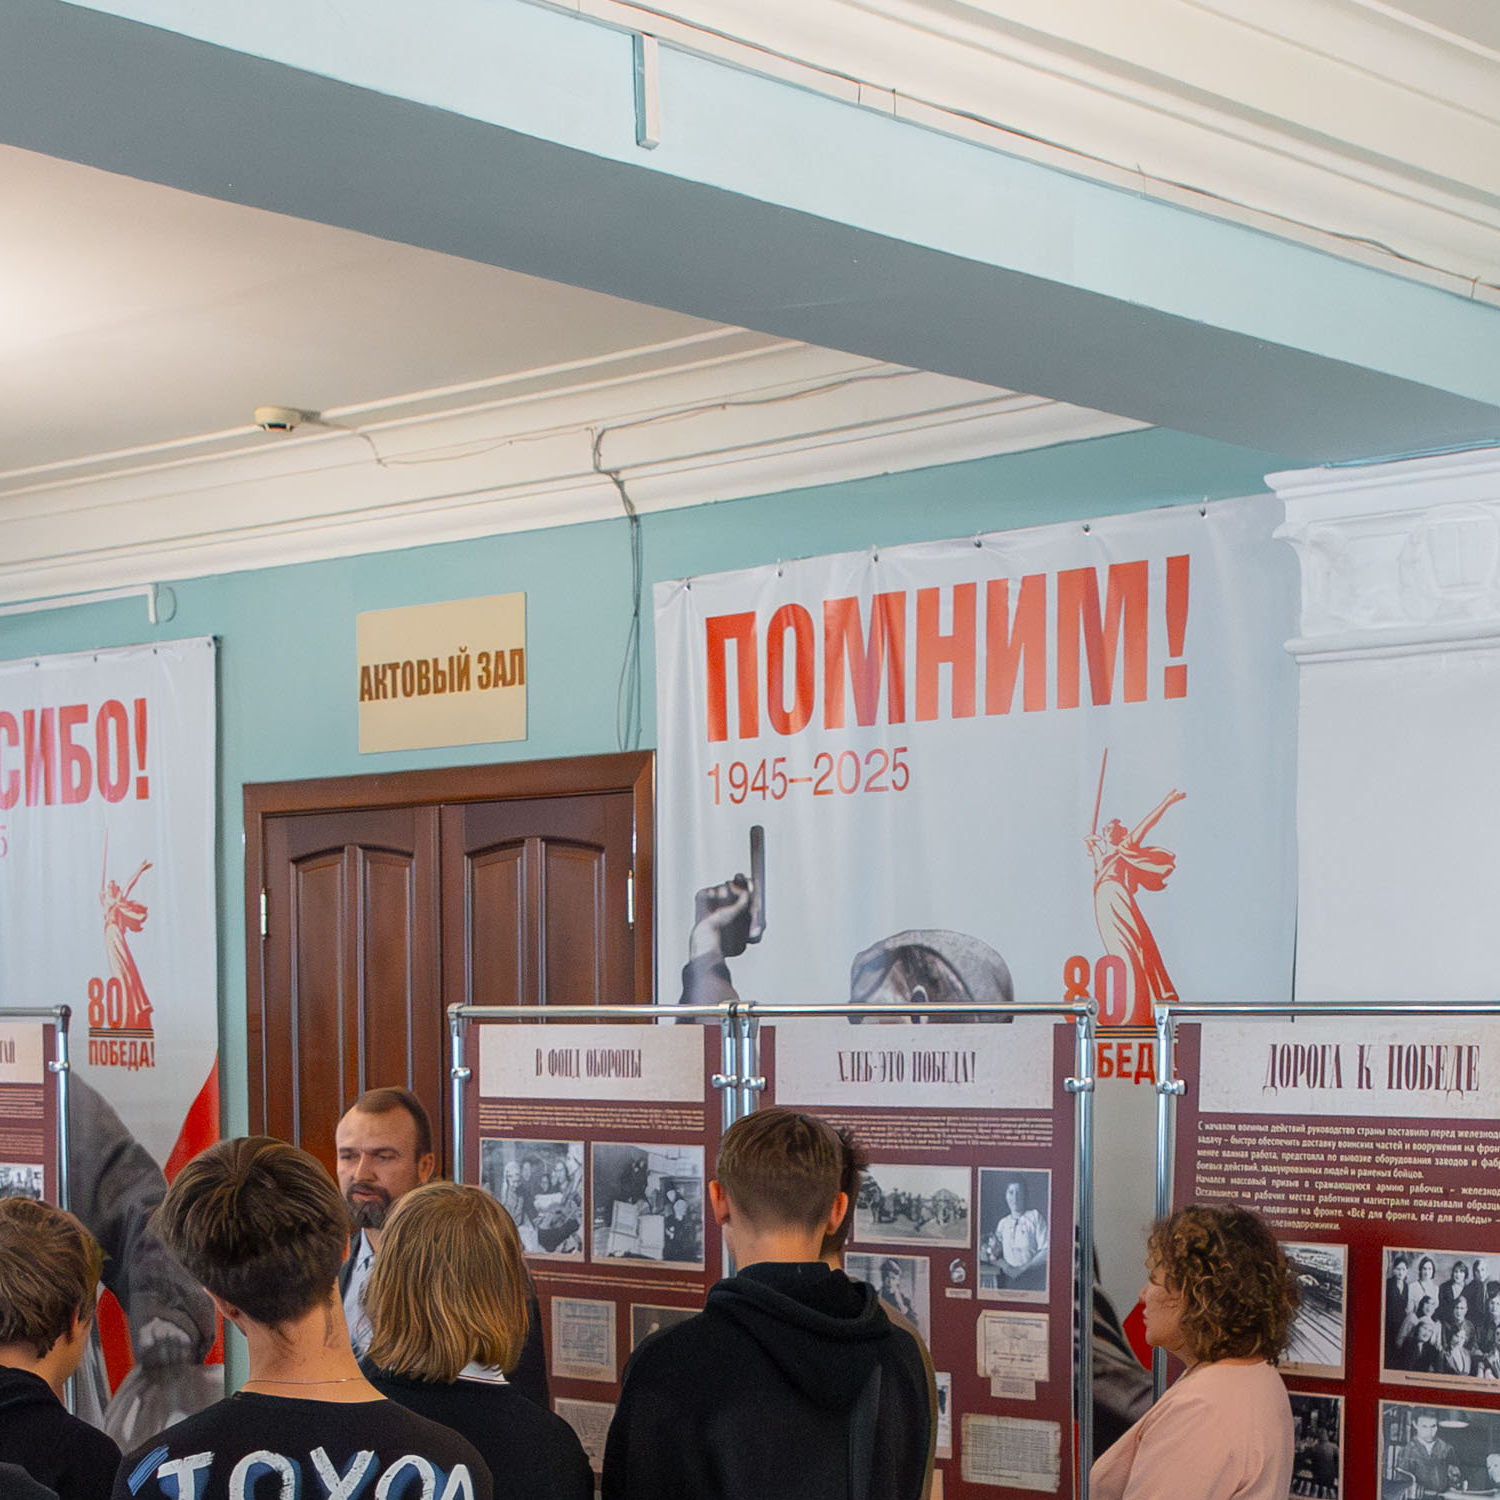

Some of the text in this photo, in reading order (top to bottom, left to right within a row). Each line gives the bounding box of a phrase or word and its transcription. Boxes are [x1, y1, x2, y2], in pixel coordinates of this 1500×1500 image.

[705, 554, 1190, 742] ПОМНИМ!
[359, 646, 525, 702] АКТОВЫЙ ЗАЛ
[87, 977, 123, 1029] 80
[88, 1040, 156, 1072] ПОБЕДА!
[536, 1048, 642, 1079] В ФОНД ОБОРОНЫ
[912, 1051, 976, 1084] ПОБЕДА!
[1092, 1042, 1178, 1085] БЕД!
[1262, 1043, 1481, 1100] ДОРОГА К ПОБЕДЕ
[1269, 1219, 1341, 1231] елезнодорожники.
